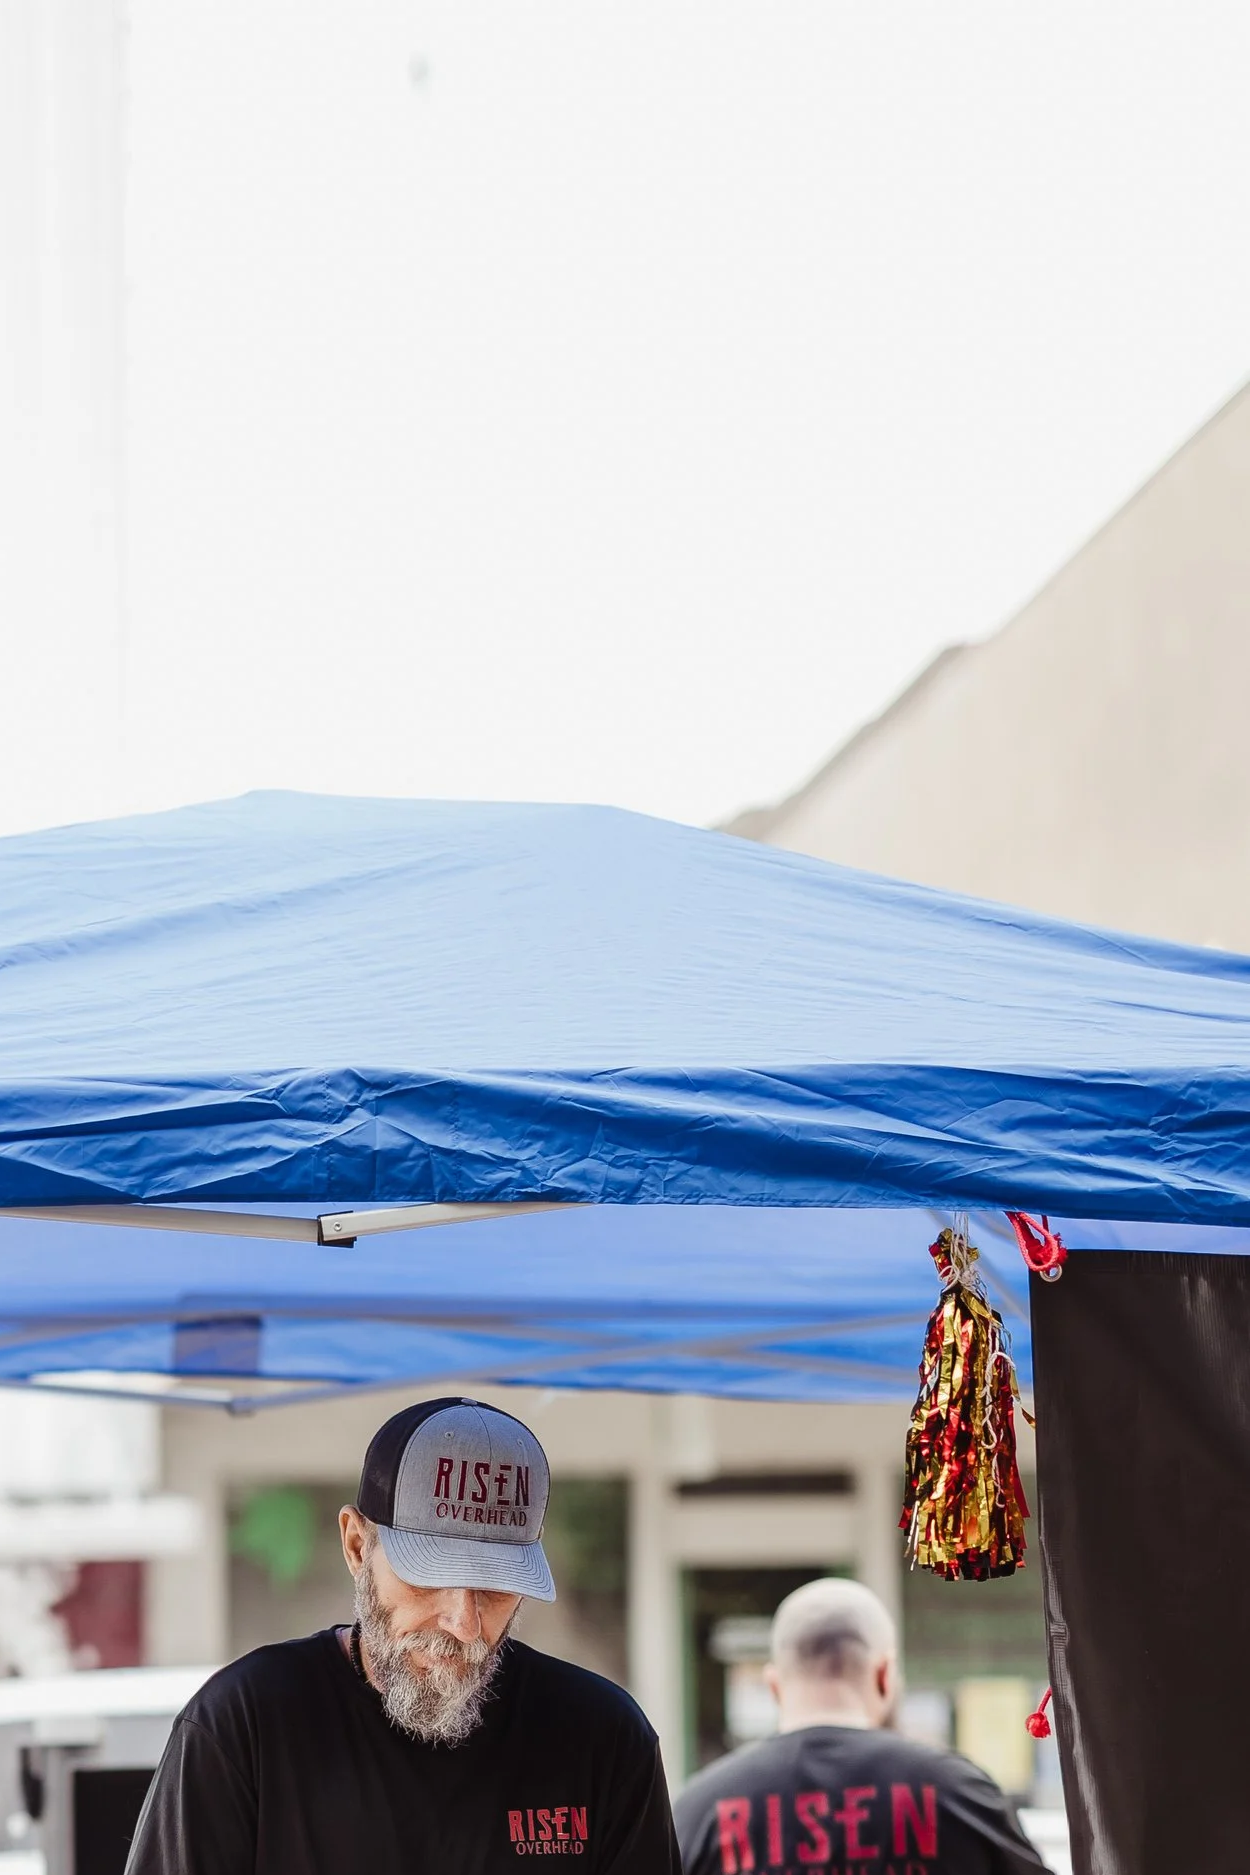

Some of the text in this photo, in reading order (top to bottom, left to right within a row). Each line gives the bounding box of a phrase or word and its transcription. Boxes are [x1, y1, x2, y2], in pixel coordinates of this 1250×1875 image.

[434, 1458, 529, 1507] RISEN
[436, 1502, 527, 1527] OVERHEAD
[508, 1807, 588, 1841] RISEN
[716, 1783, 937, 1875] RISEN
[516, 1841, 584, 1855] OVERHEAD
